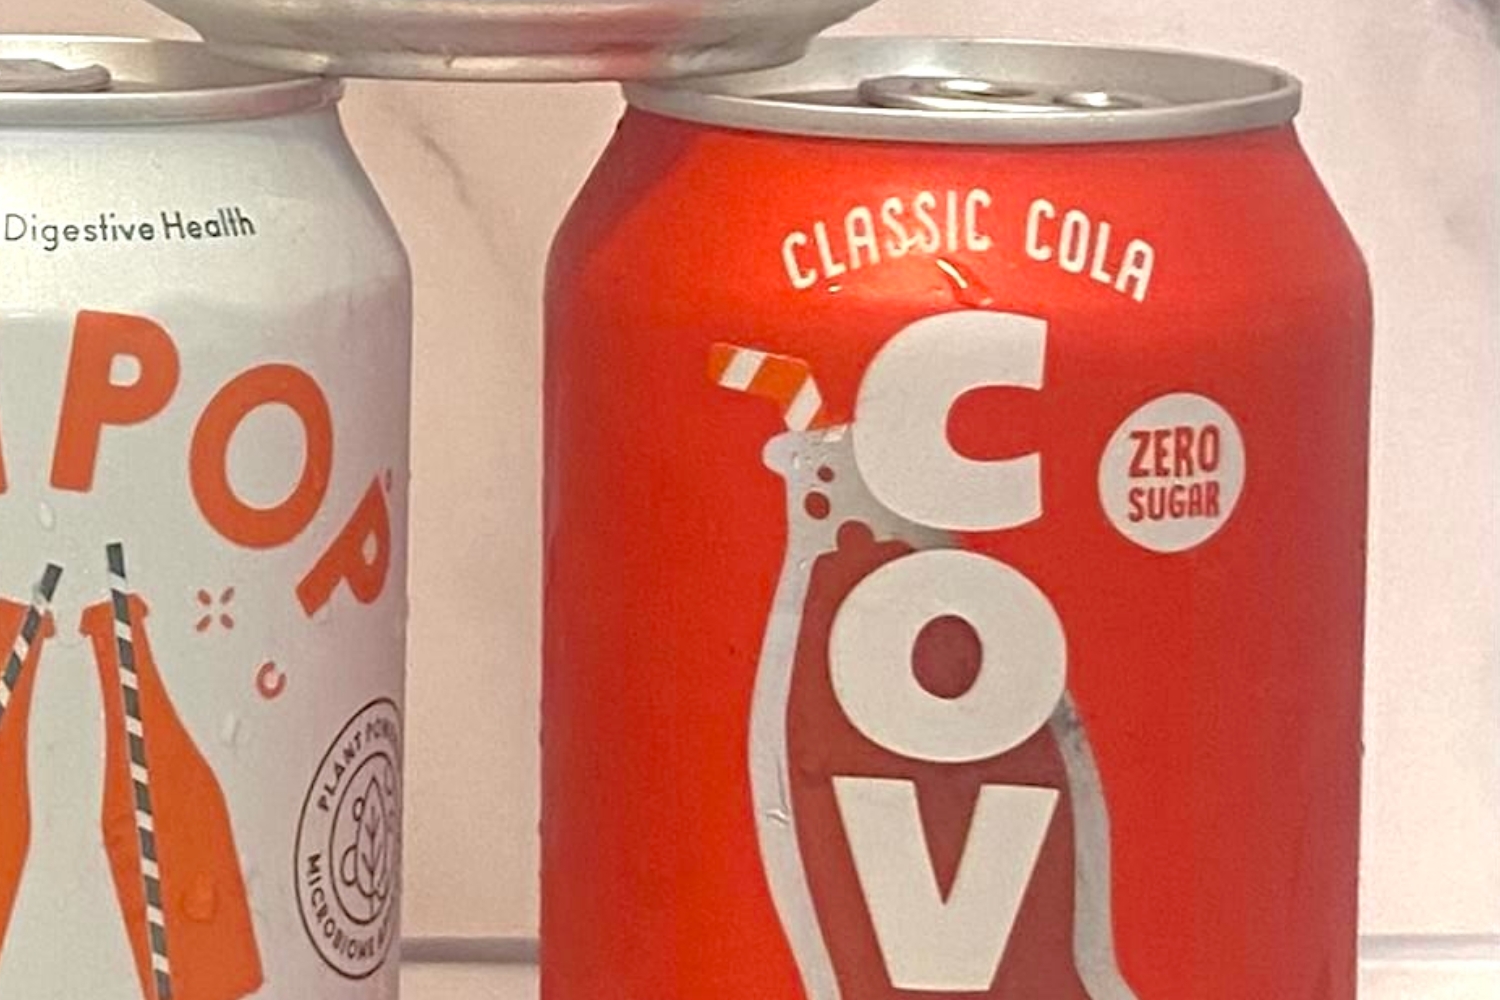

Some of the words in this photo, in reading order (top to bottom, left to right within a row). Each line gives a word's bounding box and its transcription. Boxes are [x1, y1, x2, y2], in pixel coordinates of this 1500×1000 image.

[4, 211, 156, 251] Digestive
[160, 206, 257, 240] Health
[781, 188, 994, 289] CLASSIC
[1025, 198, 1155, 303] COLA
[1129, 424, 1220, 477] ZERO
[1128, 480, 1220, 523] SUGAR
[318, 731, 362, 812] PLANT
